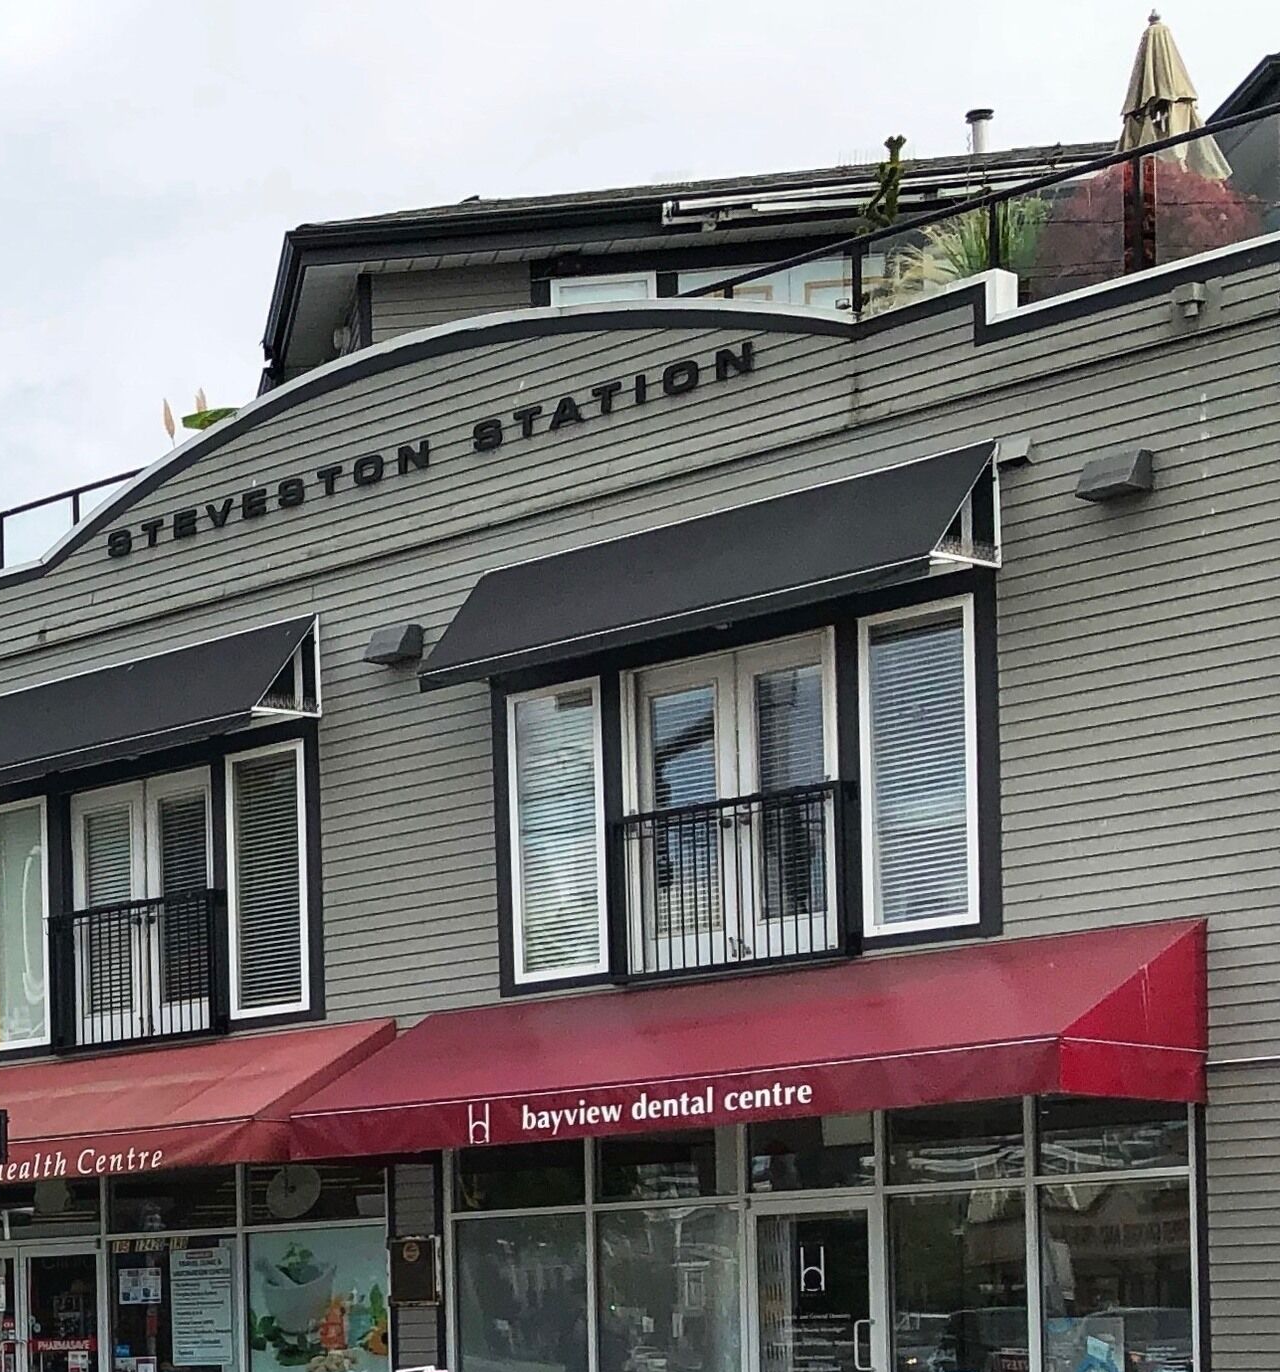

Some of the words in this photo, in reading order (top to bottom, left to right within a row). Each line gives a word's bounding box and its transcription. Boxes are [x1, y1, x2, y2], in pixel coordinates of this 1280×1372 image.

[106, 440, 430, 558] STEVESTON
[472, 341, 753, 452] STATION
[521, 1099, 622, 1135] bayview
[631, 1086, 714, 1121] dental
[724, 1082, 813, 1112] centre
[76, 1146, 163, 1175] Centre
